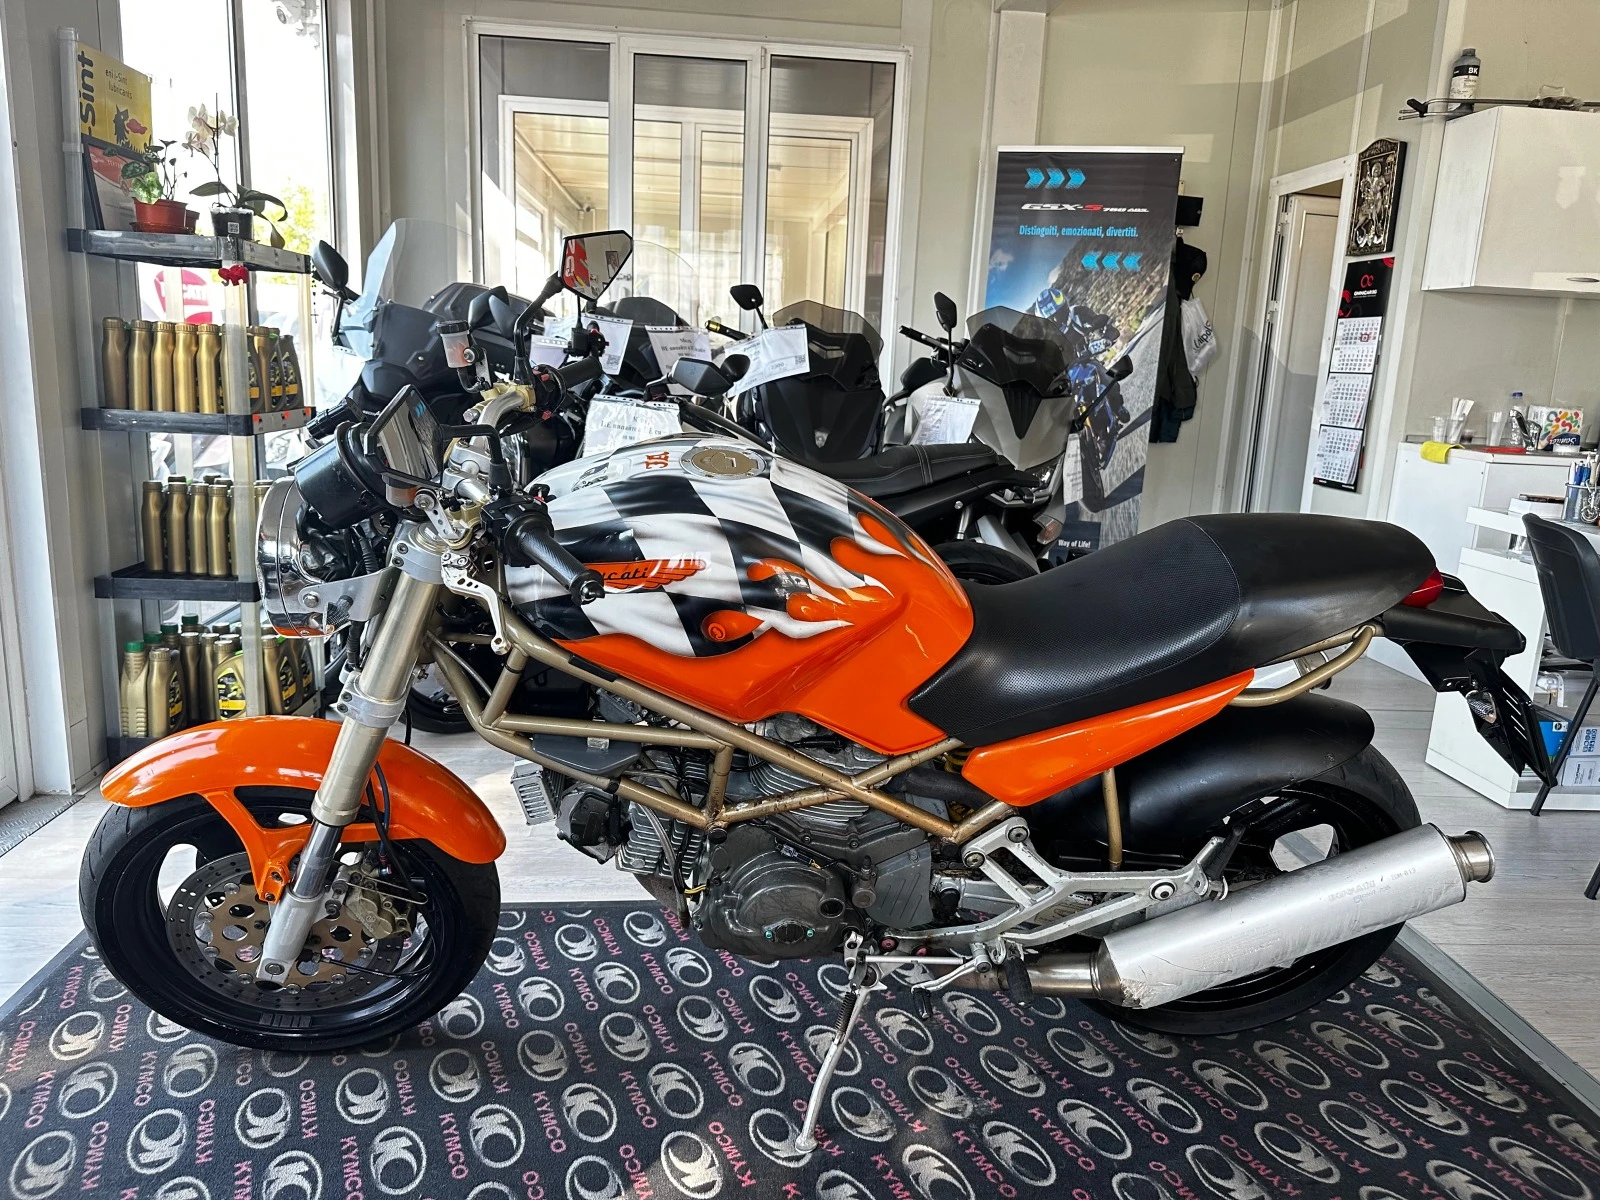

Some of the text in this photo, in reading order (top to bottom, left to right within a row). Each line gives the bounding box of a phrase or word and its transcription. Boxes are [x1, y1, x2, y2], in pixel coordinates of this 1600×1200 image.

[78, 51, 95, 136] -Sint
[108, 81, 132, 99] lubricants
[1019, 225, 1139, 238] Distinguiti, emozionati, divertiti.
[1058, 539, 1070, 548] Way
[524, 932, 551, 971] KYMCO
[594, 918, 622, 956] KYMCO
[717, 949, 744, 977] MCO
[60, 965, 84, 1009] KYMCO
[568, 967, 598, 1011] KYMCO
[640, 952, 674, 995] KYMCO
[785, 972, 827, 1017] KYMCO
[109, 1004, 133, 1051] KYMCO
[492, 982, 520, 1029] KYMCO
[643, 1004, 678, 1053] KYMCO
[716, 988, 755, 1034] KYMCO
[992, 990, 1035, 1026] YMCO
[1396, 994, 1473, 1040] KYMCO
[6, 1020, 36, 1073] KYMCO
[564, 1022, 597, 1073] KYMCO
[1079, 1020, 1141, 1068] KYMCO
[1287, 1028, 1362, 1078] KYMCO
[1343, 1011, 1420, 1058] KYMCO
[134, 1051, 158, 1107] KYMCO
[394, 1059, 416, 1116] KYMCO
[482, 1040, 511, 1094] KYMCO
[702, 1051, 744, 1107] KYMCO
[945, 1057, 1003, 1110] KYMCO
[1013, 1037, 1074, 1090] KYMCO
[1231, 1048, 1301, 1099] KYMCO
[1462, 1052, 1550, 1104] KYMCO
[24, 1069, 56, 1128] KYMCO
[300, 1079, 318, 1139] KYMCO
[619, 1070, 657, 1128] KYMCO
[871, 1078, 928, 1133] KYMCO
[1098, 1086, 1168, 1144] KYMCO
[1165, 1066, 1237, 1120] KYMCO
[1408, 1071, 1495, 1127] KYMCO
[196, 1099, 215, 1164] KYMCO
[439, 1112, 468, 1180] KYMCO
[532, 1091, 566, 1153] KYMCO
[793, 1099, 845, 1156] KYMO
[1028, 1107, 1095, 1172] KYMCO
[1286, 1113, 1370, 1174] KYMCO
[1348, 1092, 1436, 1149] KYMCO
[82, 1121, 110, 1191] KYMCO
[619, 1144, 653, 1200] YMCO
[709, 1122, 756, 1187] KYMCO
[952, 1130, 1017, 1198] KYMCO
[1219, 1135, 1300, 1196] KYMCO
[1462, 1146, 1546, 1200] KYMC
[1522, 1122, 1600, 1173] KYMC
[234, 1161, 252, 1200] KYM
[870, 1153, 912, 1200] KYM
